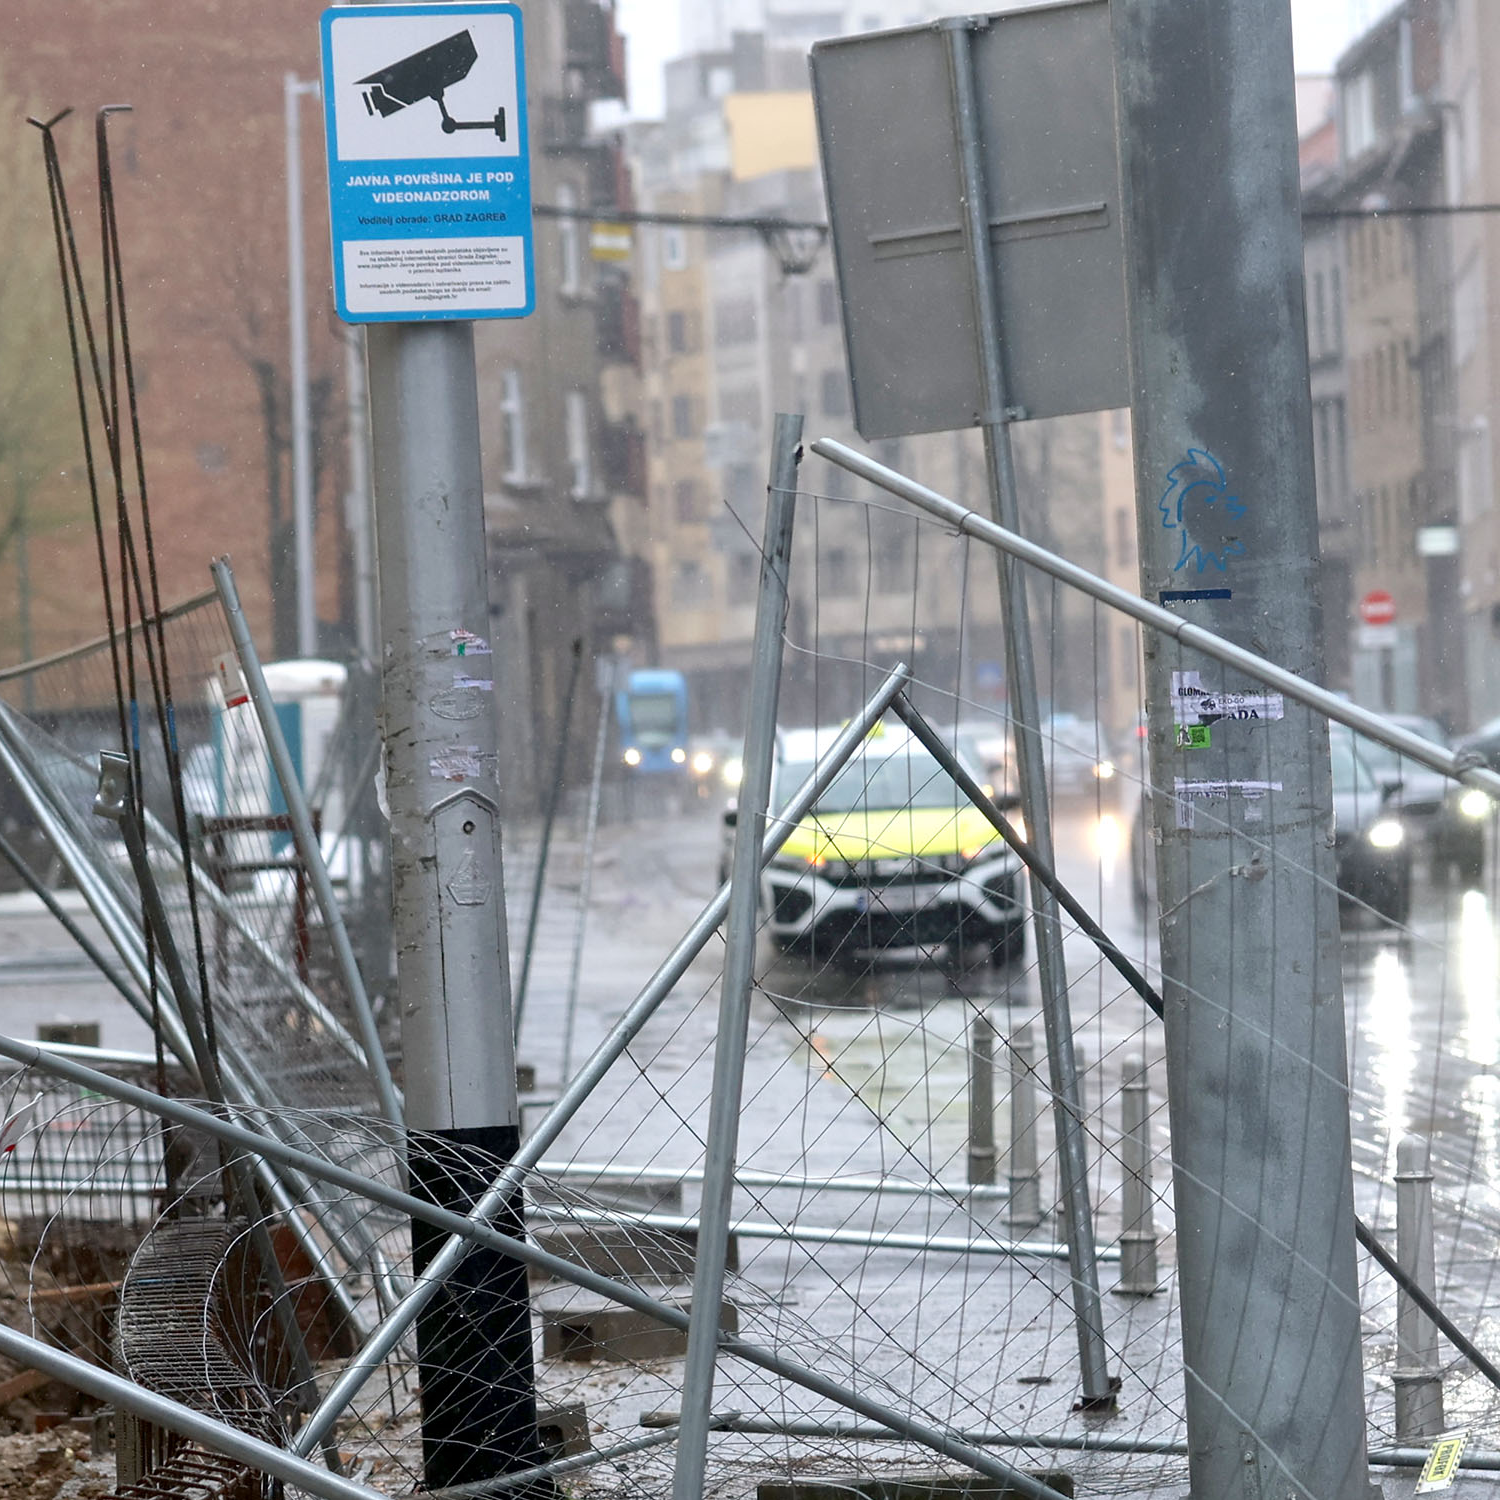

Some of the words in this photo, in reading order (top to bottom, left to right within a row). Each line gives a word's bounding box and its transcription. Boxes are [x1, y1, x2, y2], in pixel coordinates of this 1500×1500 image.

[346, 175, 392, 186] JAVNA
[394, 171, 463, 186] POVRŠINA
[466, 172, 483, 184] JE
[486, 171, 514, 183] POD
[372, 190, 490, 203] VIDEONADZOROM
[358, 214, 393, 226] Voditelj
[396, 214, 431, 224] obrade:
[434, 213, 462, 223] GRAD
[465, 212, 507, 222] ZAGREB
